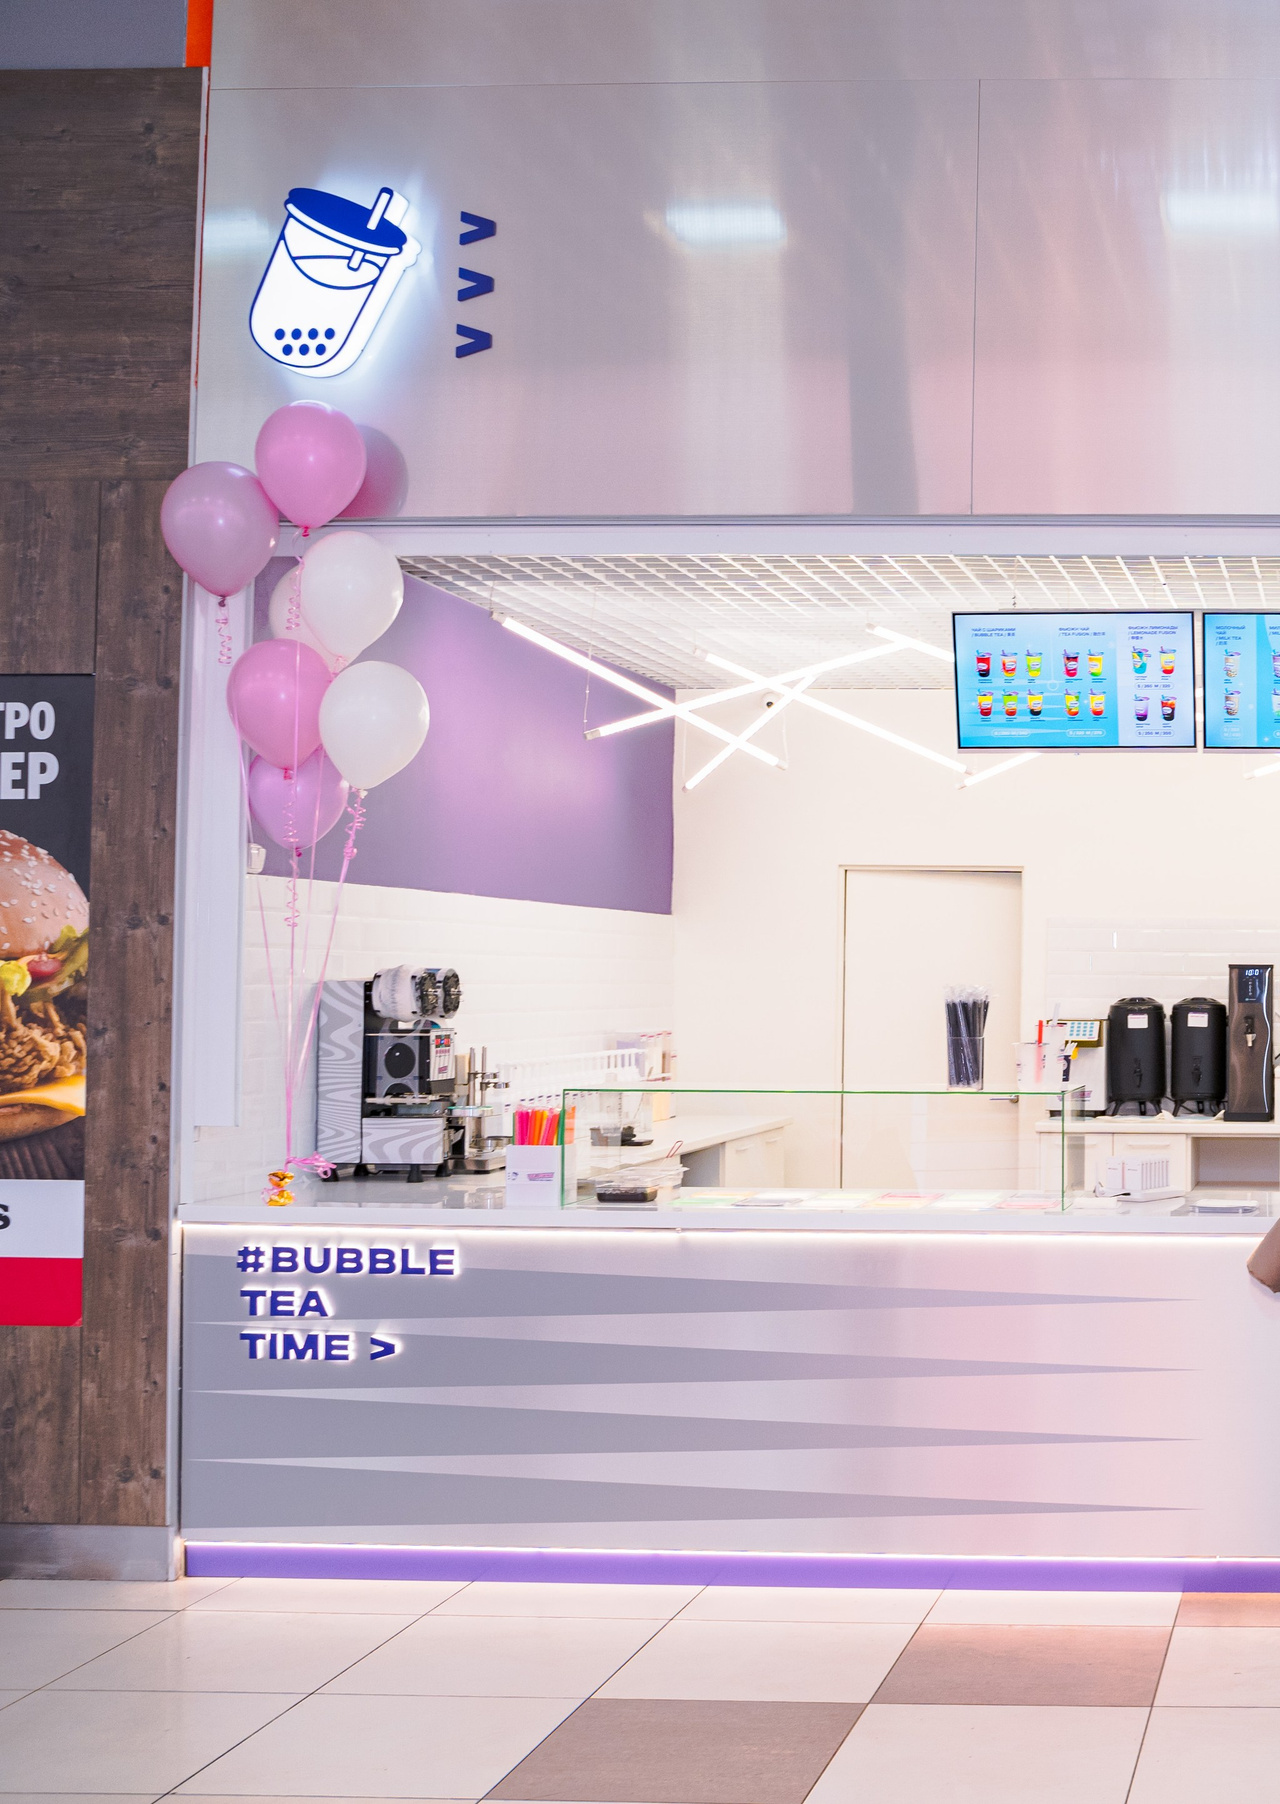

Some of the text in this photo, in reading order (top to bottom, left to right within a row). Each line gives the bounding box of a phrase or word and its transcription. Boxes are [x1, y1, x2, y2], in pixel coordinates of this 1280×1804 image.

[0, 701, 56, 740] РО
[237, 1246, 455, 1276] #BUBBLE
[240, 1289, 329, 1317] TEA
[239, 1332, 350, 1361] TIME
